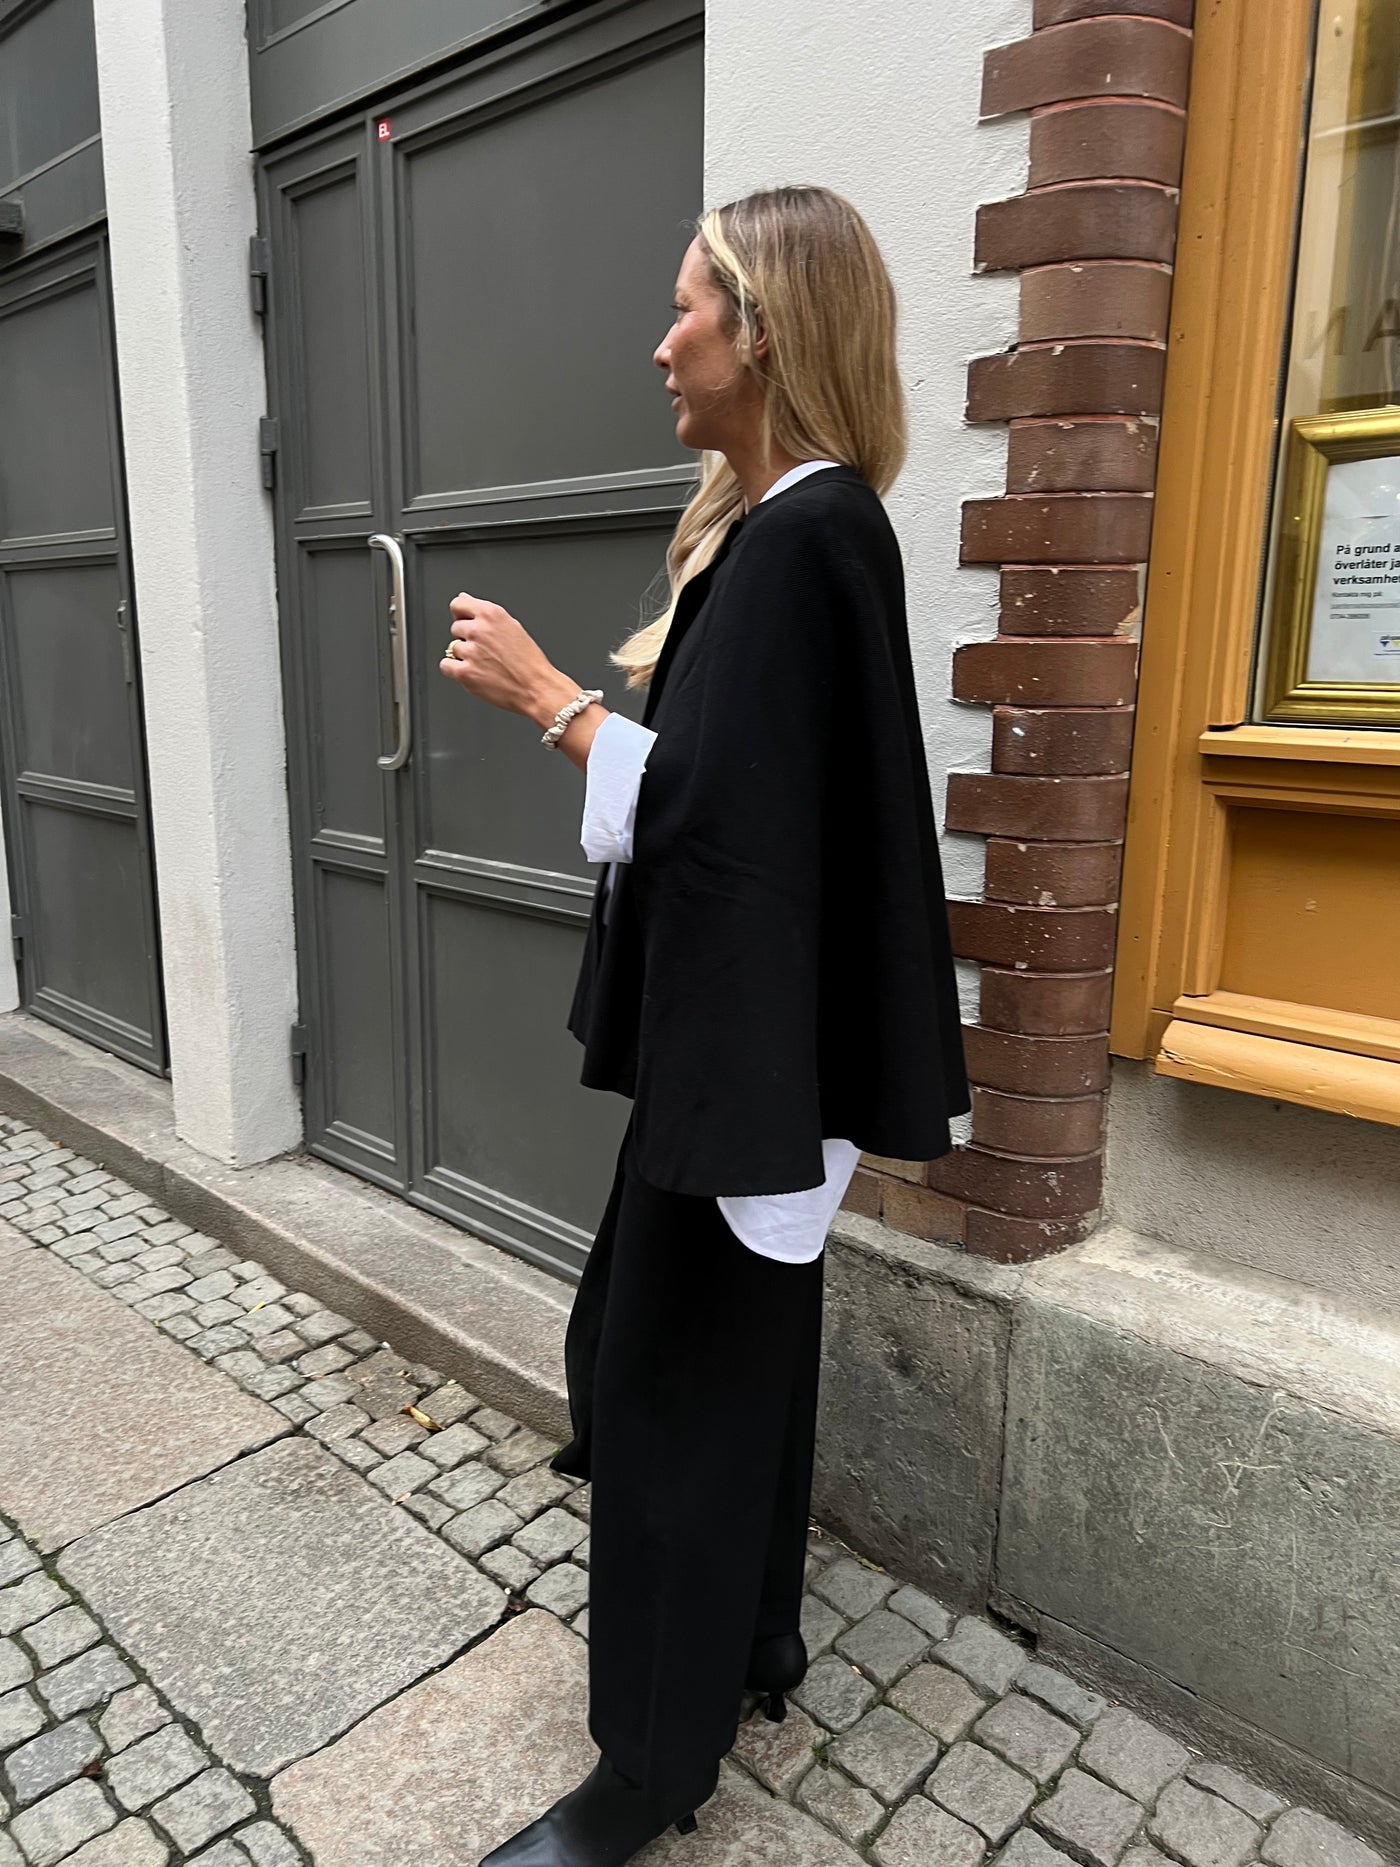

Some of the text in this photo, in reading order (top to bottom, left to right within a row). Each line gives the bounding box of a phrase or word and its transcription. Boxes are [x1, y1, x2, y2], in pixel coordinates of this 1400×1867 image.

[379, 123, 390, 138] EL
[1336, 544, 1351, 554] På
[1354, 543, 1391, 557] grund
[1334, 558, 1388, 570] överlåter
